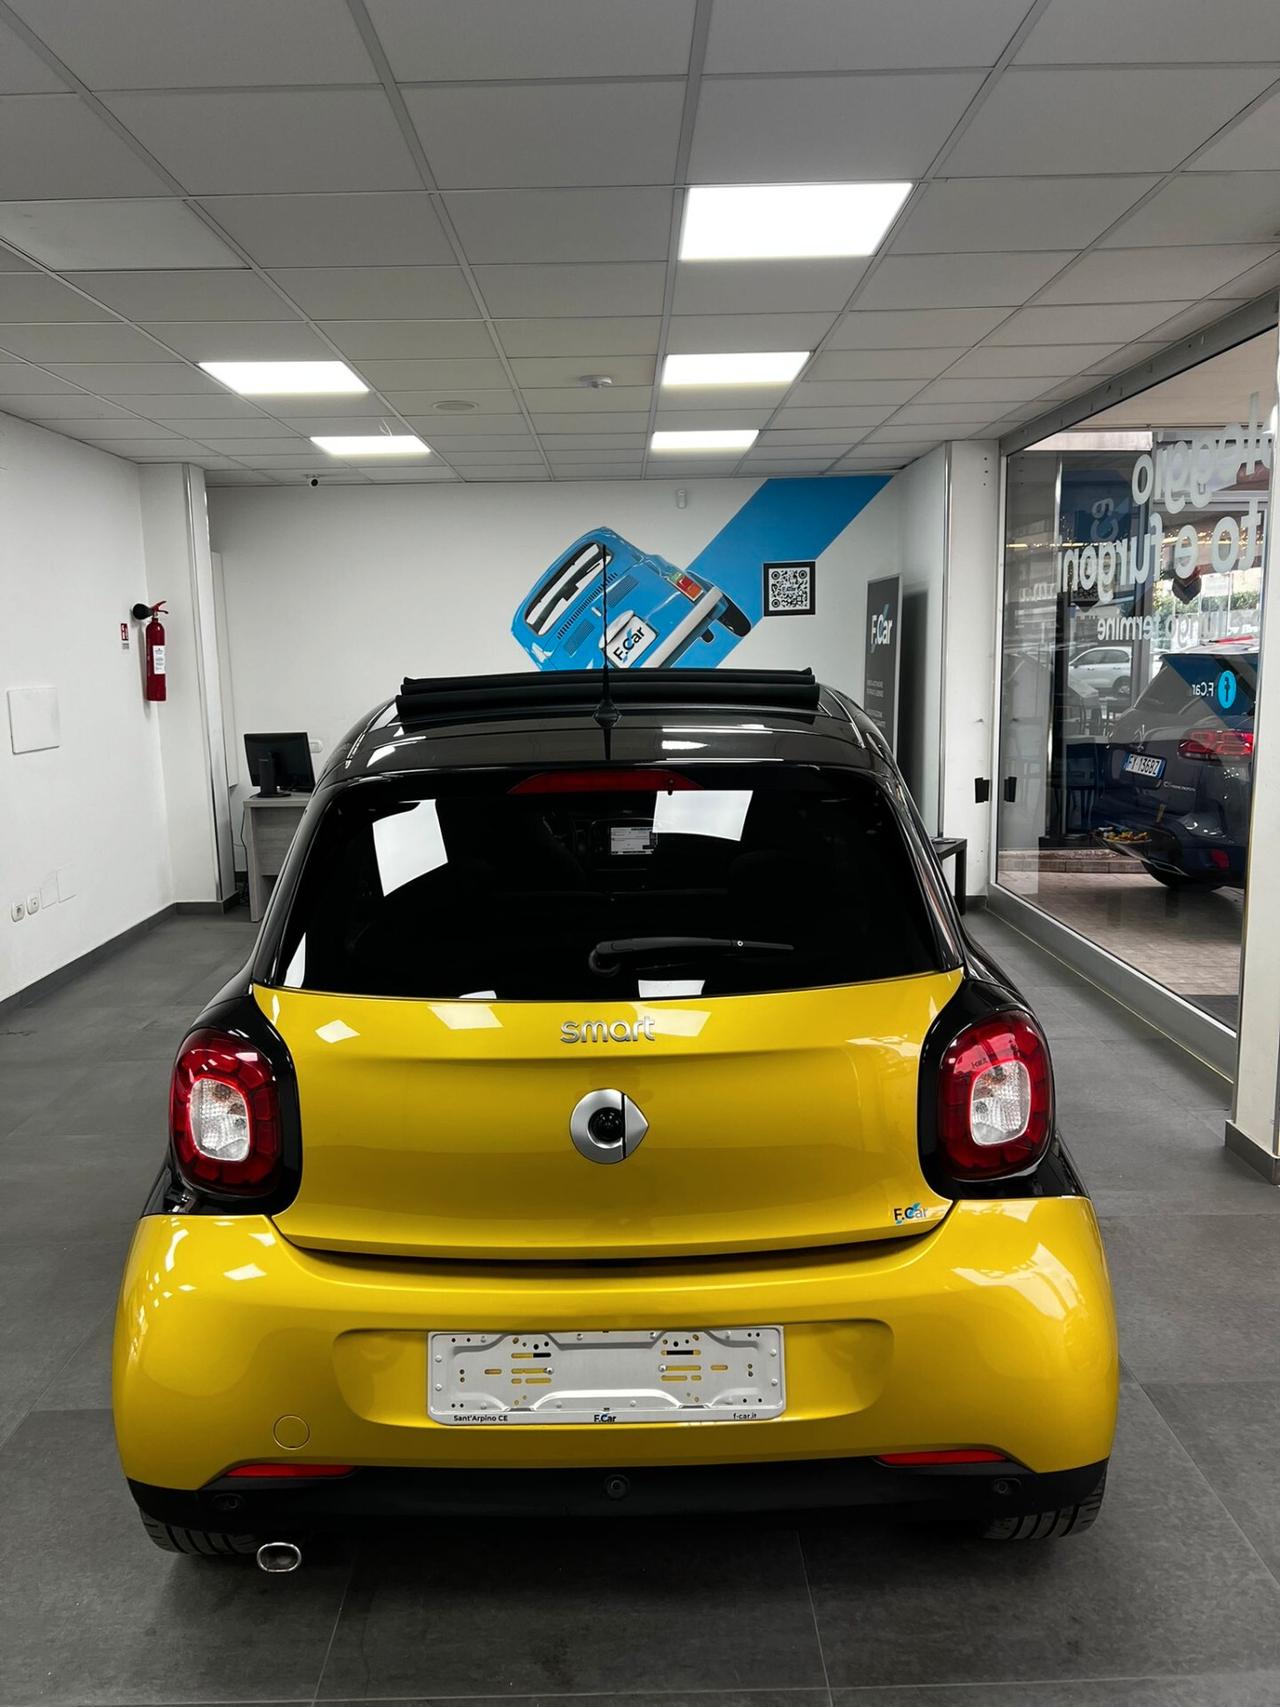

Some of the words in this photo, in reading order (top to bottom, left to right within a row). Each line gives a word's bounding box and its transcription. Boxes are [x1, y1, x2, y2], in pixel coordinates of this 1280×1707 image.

[871, 614, 893, 645] F.Car
[613, 627, 644, 662] F.Car
[560, 1016, 656, 1044] smart
[893, 1204, 928, 1222] F.Car
[453, 1414, 497, 1423] Sant'Arpino
[593, 1413, 617, 1423] F.Car
[733, 1412, 757, 1420] f-car.it
